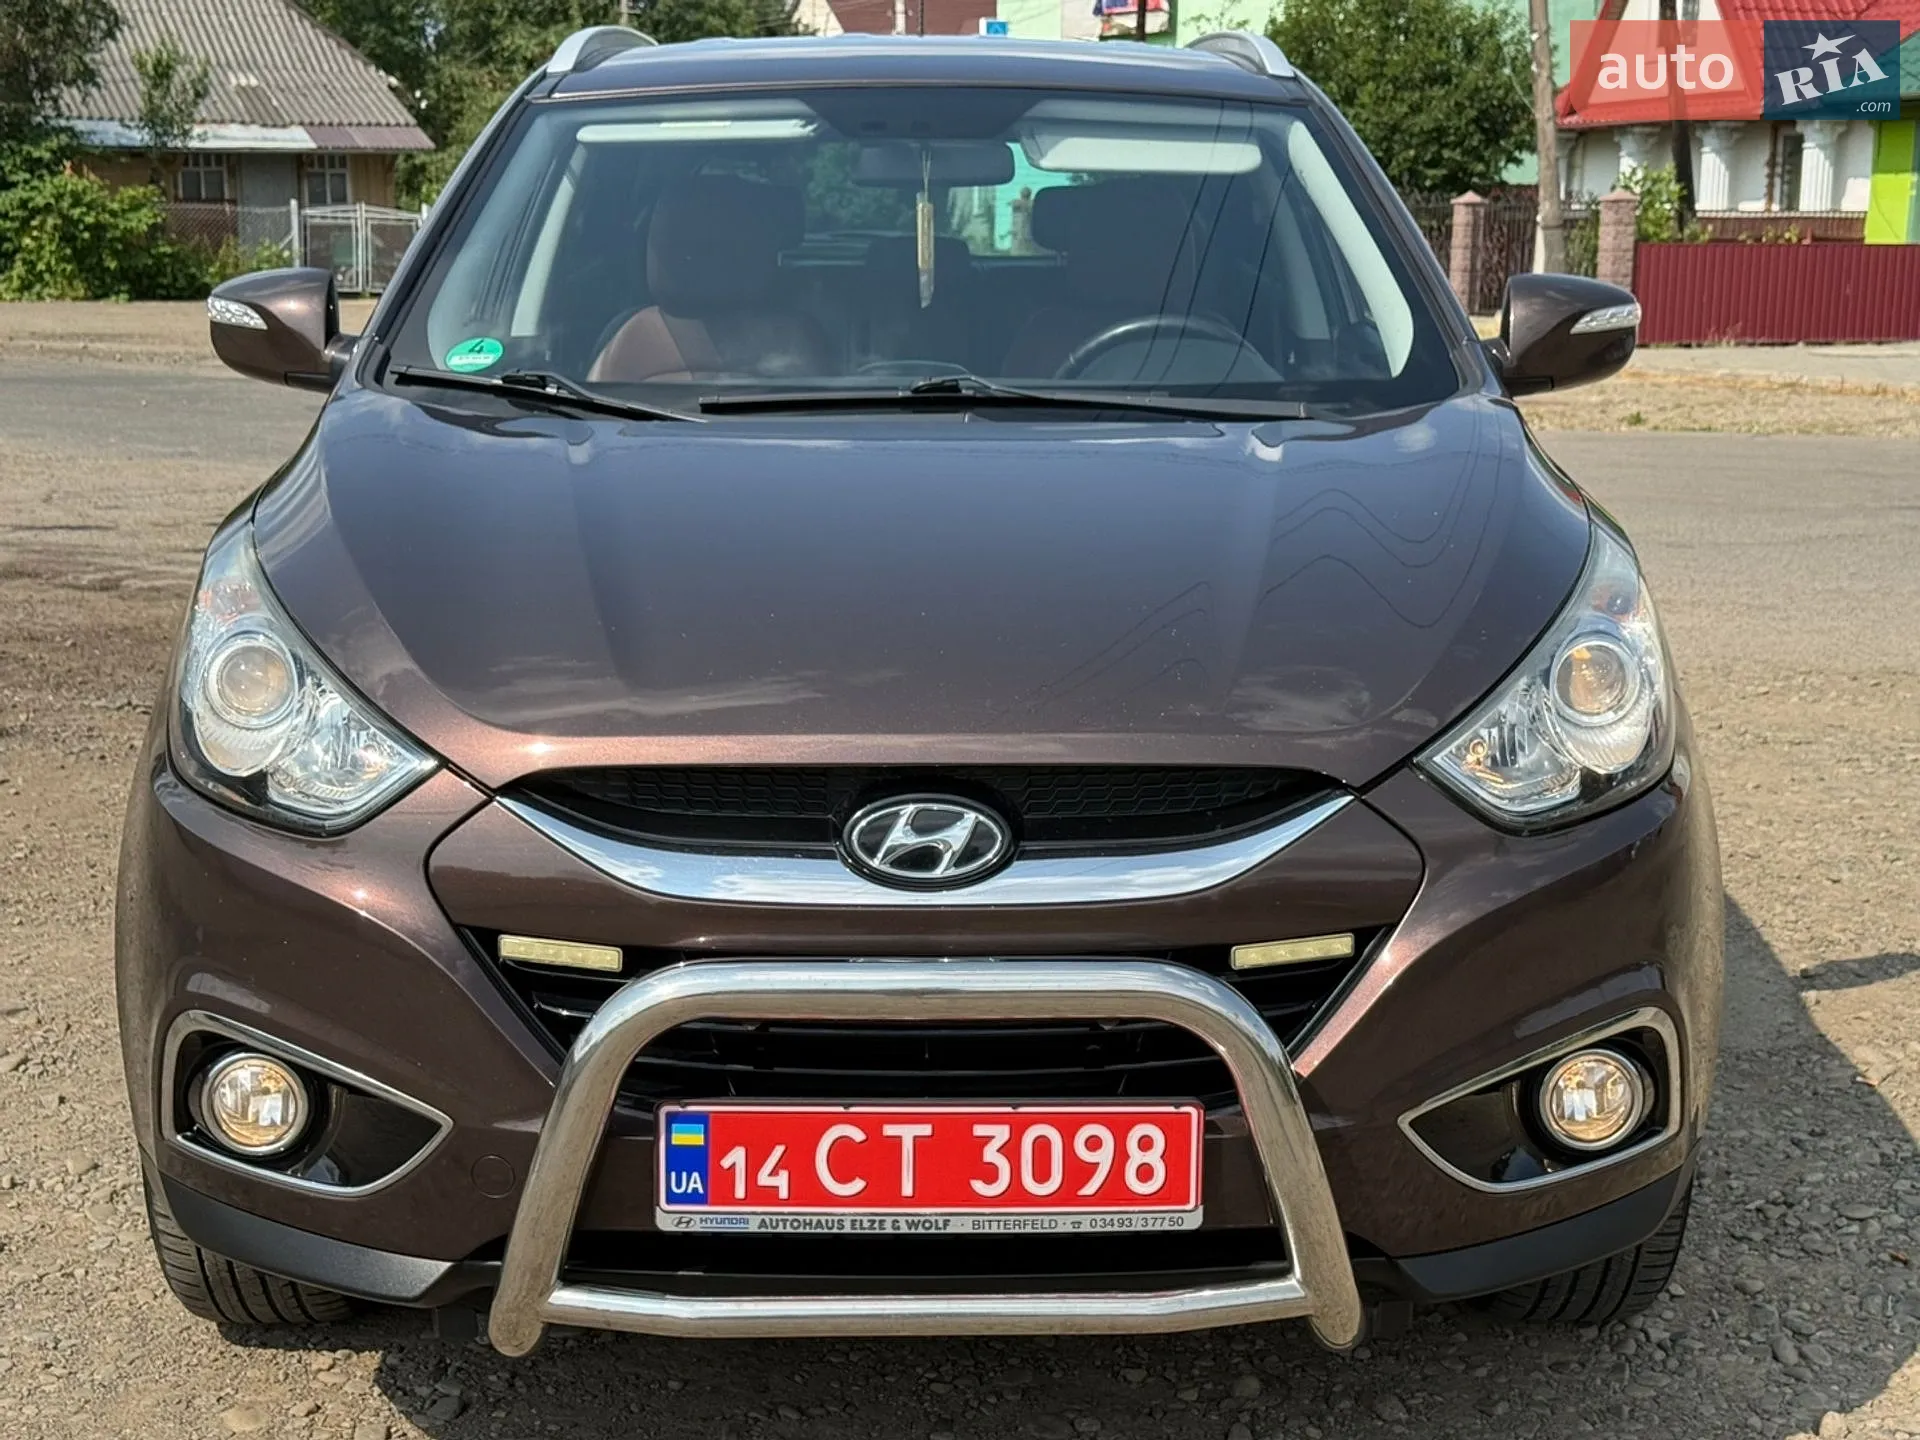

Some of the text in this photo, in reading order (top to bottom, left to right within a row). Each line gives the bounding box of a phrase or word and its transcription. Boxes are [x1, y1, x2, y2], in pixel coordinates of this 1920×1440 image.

[720, 1123, 1167, 1200] 14 CT 3098
[670, 1171, 704, 1194] UA
[700, 1216, 1185, 1231] HYUNDAI AUTOHAUS ELZE & WOLF BITTERFELD 03493/37750
